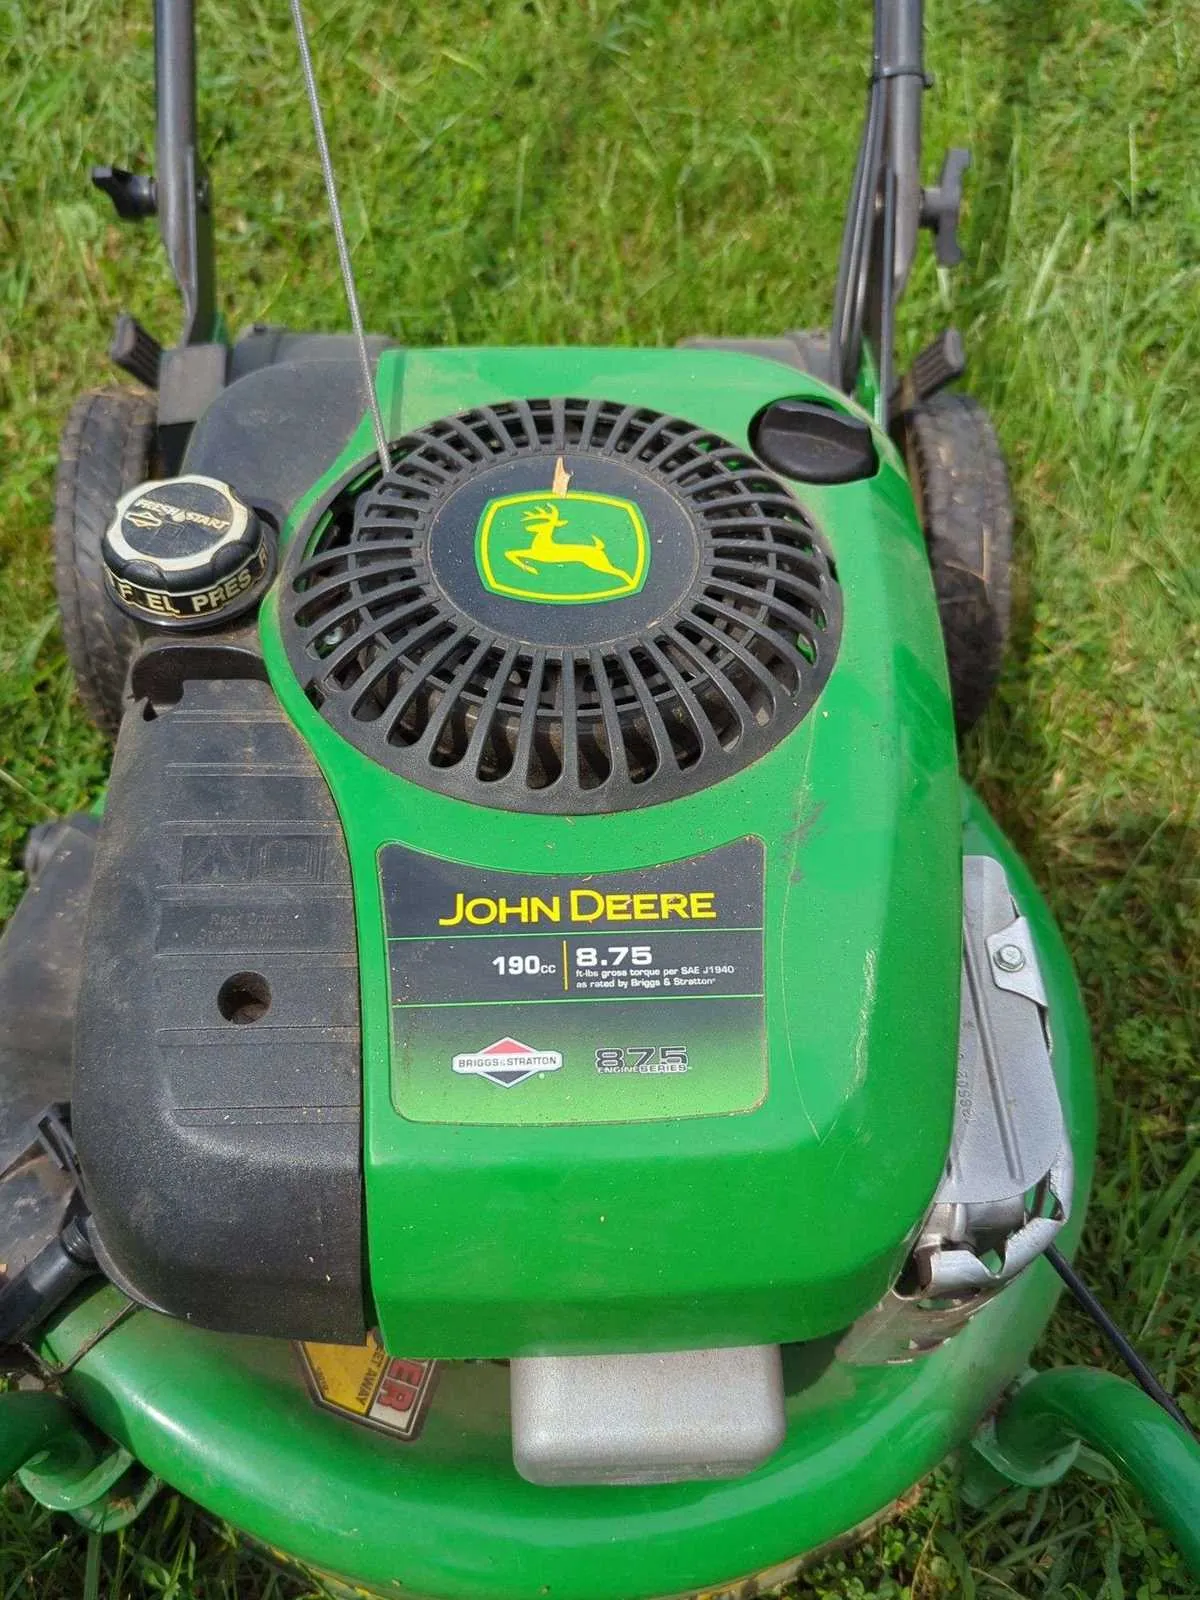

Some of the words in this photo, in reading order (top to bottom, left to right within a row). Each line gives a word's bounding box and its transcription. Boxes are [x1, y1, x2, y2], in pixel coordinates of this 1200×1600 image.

[184, 511, 230, 530] START
[119, 584, 181, 614] FEL
[438, 892, 561, 926] JOHN
[569, 888, 717, 922] DEERE
[575, 945, 653, 967] 8.75
[601, 970, 627, 979] gross
[629, 968, 661, 979] torque
[663, 968, 679, 977] per
[681, 966, 701, 976] SAE
[703, 964, 735, 974] J1940
[590, 978, 615, 988] rated
[617, 978, 628, 989] by
[630, 977, 661, 988] Briggs
[663, 978, 671, 986] &
[594, 1045, 689, 1070] 875
[597, 1065, 640, 1074] ENGINE
[639, 1063, 689, 1074] SERIES
[356, 1366, 379, 1406] AWAY
